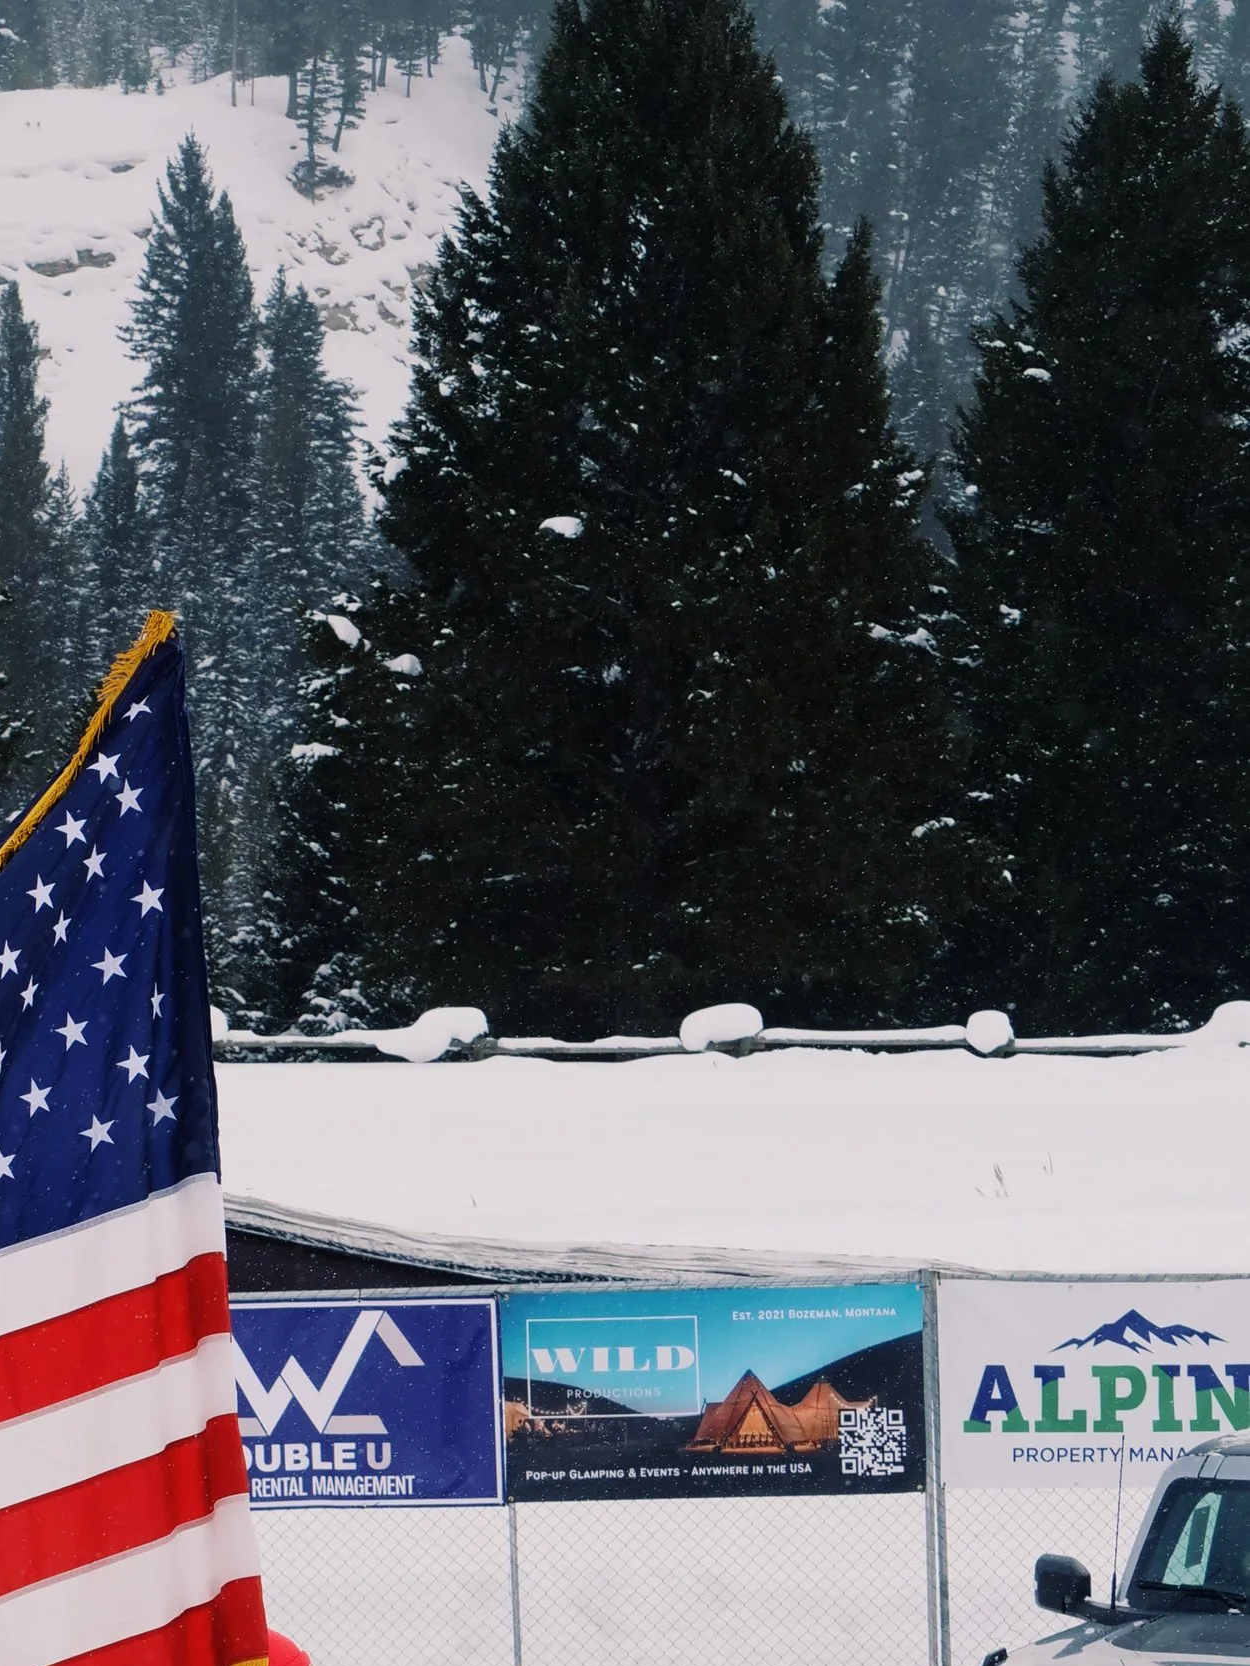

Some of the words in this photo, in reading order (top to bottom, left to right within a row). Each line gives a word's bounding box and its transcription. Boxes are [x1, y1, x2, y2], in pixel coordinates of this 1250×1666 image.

[732, 1310, 754, 1321] EST.
[758, 1309, 784, 1320] 2021
[845, 1307, 897, 1317] MONTANA
[530, 1345, 695, 1374] WILD
[566, 1386, 662, 1400] PRODUCTIONS
[366, 1442, 392, 1471] U
[1012, 1447, 1122, 1463] PROPERTY
[526, 1470, 566, 1480] POP-UP
[569, 1469, 625, 1480] GLAMPING
[628, 1467, 637, 1479] &
[640, 1467, 680, 1477] EVENTS
[691, 1465, 749, 1476] ANYWHERE
[752, 1465, 764, 1475] IN
[767, 1464, 786, 1474] THE
[790, 1463, 812, 1473] USA
[251, 1477, 308, 1498] RENTAL
[312, 1475, 415, 1496] MANAGEMENT
